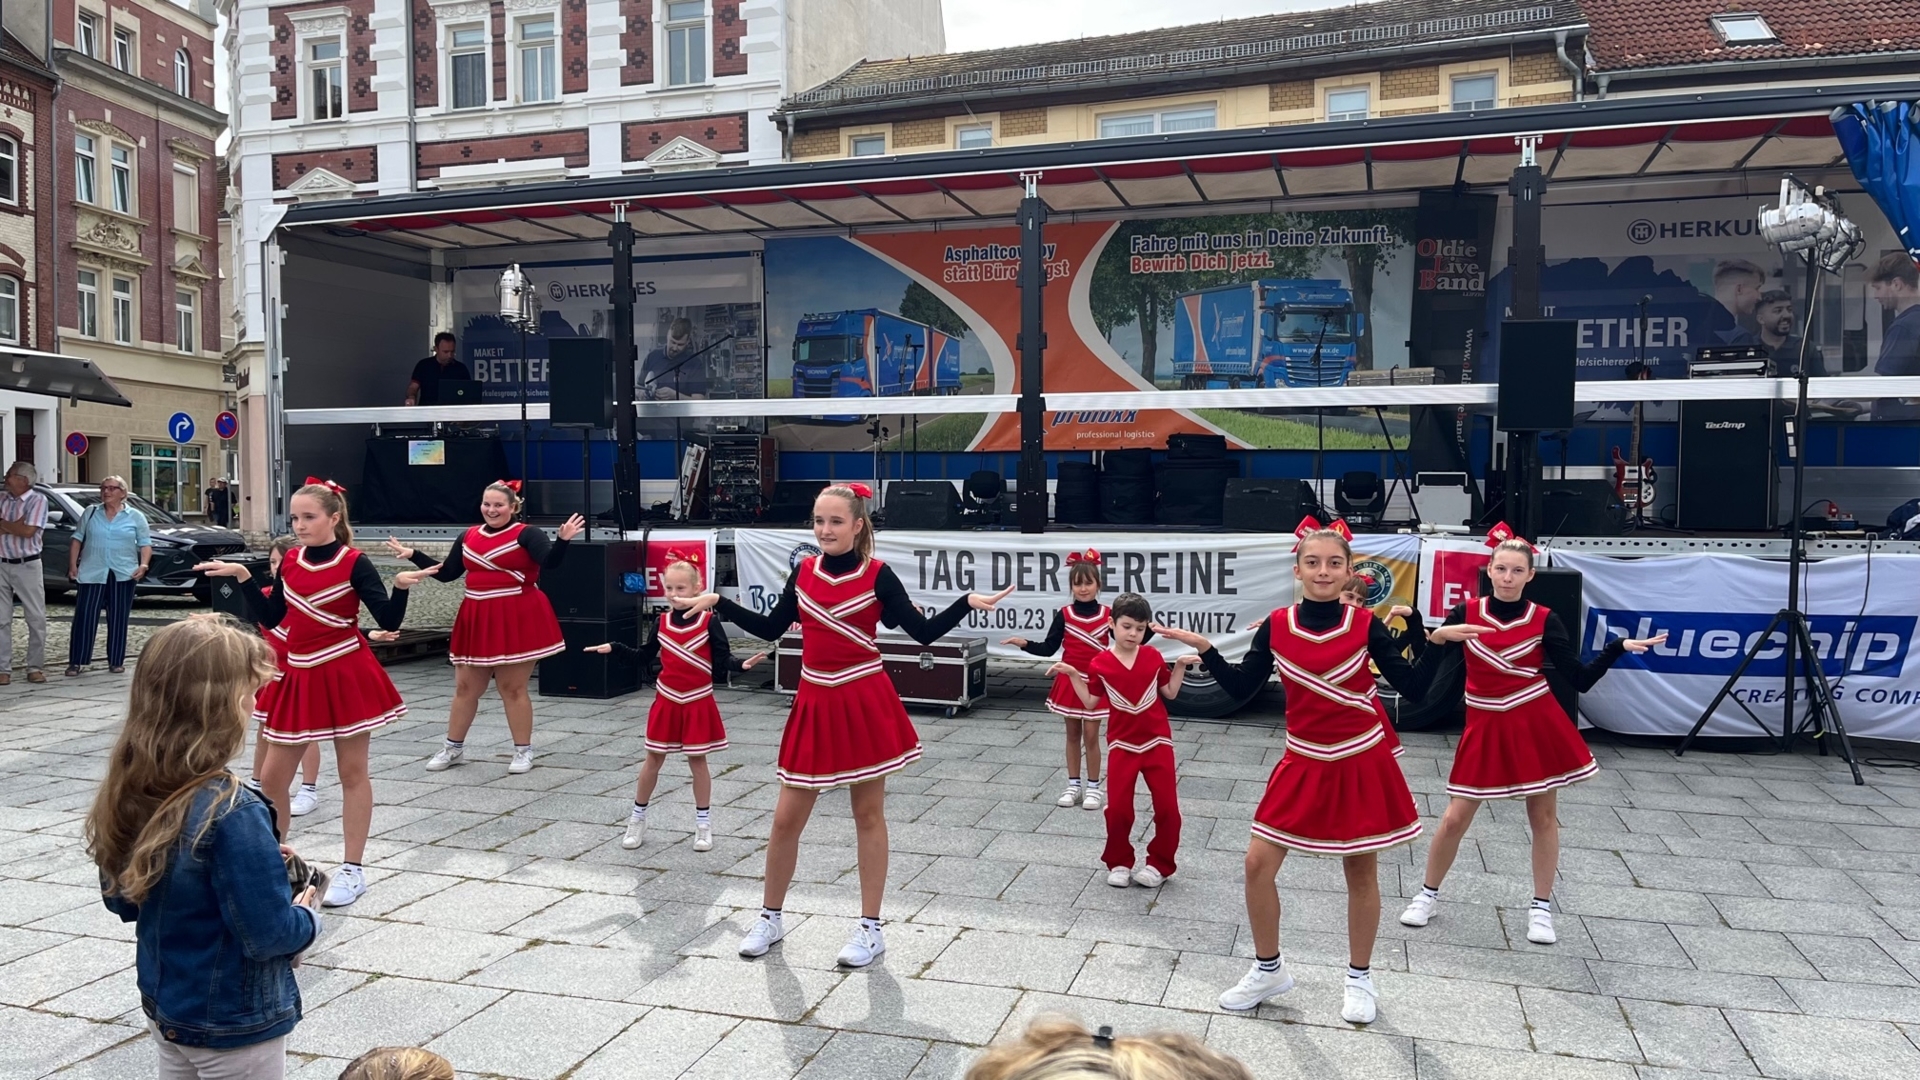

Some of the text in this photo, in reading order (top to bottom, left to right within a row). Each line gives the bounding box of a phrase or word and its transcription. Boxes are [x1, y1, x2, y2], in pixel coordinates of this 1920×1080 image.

[1131, 225, 1393, 253] Fahre mit uns in Deine Zukunft.
[1417, 238, 1477, 257] Oldie
[944, 243, 1056, 265] Asphaltcoy
[1131, 251, 1274, 273] Bewirb Dich jetzt.
[1433, 255, 1479, 274] Live
[944, 259, 1069, 282] statt Bürogst
[1418, 269, 1485, 291] Band
[567, 281, 656, 298] HERKES
[1577, 317, 1689, 348] ETHER
[474, 348, 504, 357] MAKE IT
[1076, 430, 1155, 439] professional logistics
[1705, 421, 1746, 430] TecAmp
[914, 550, 1237, 594] TAG DER EREINE
[968, 607, 1045, 630] 03.09.23
